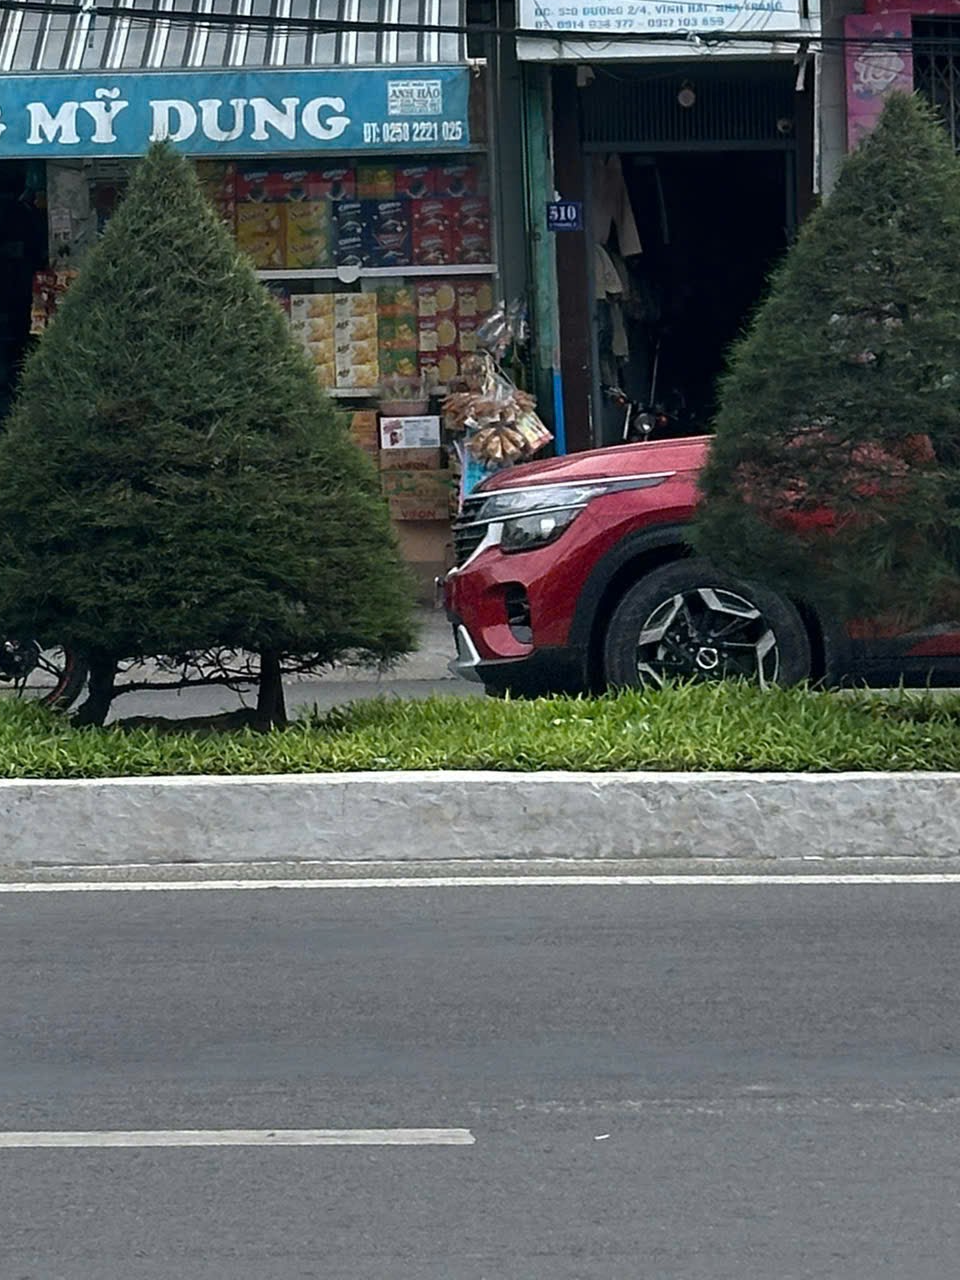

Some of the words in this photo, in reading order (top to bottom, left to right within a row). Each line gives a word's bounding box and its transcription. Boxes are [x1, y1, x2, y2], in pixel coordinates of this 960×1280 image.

[25, 87, 129, 145] MỸ
[148, 96, 351, 144] DUNG
[549, 205, 576, 221] 510
